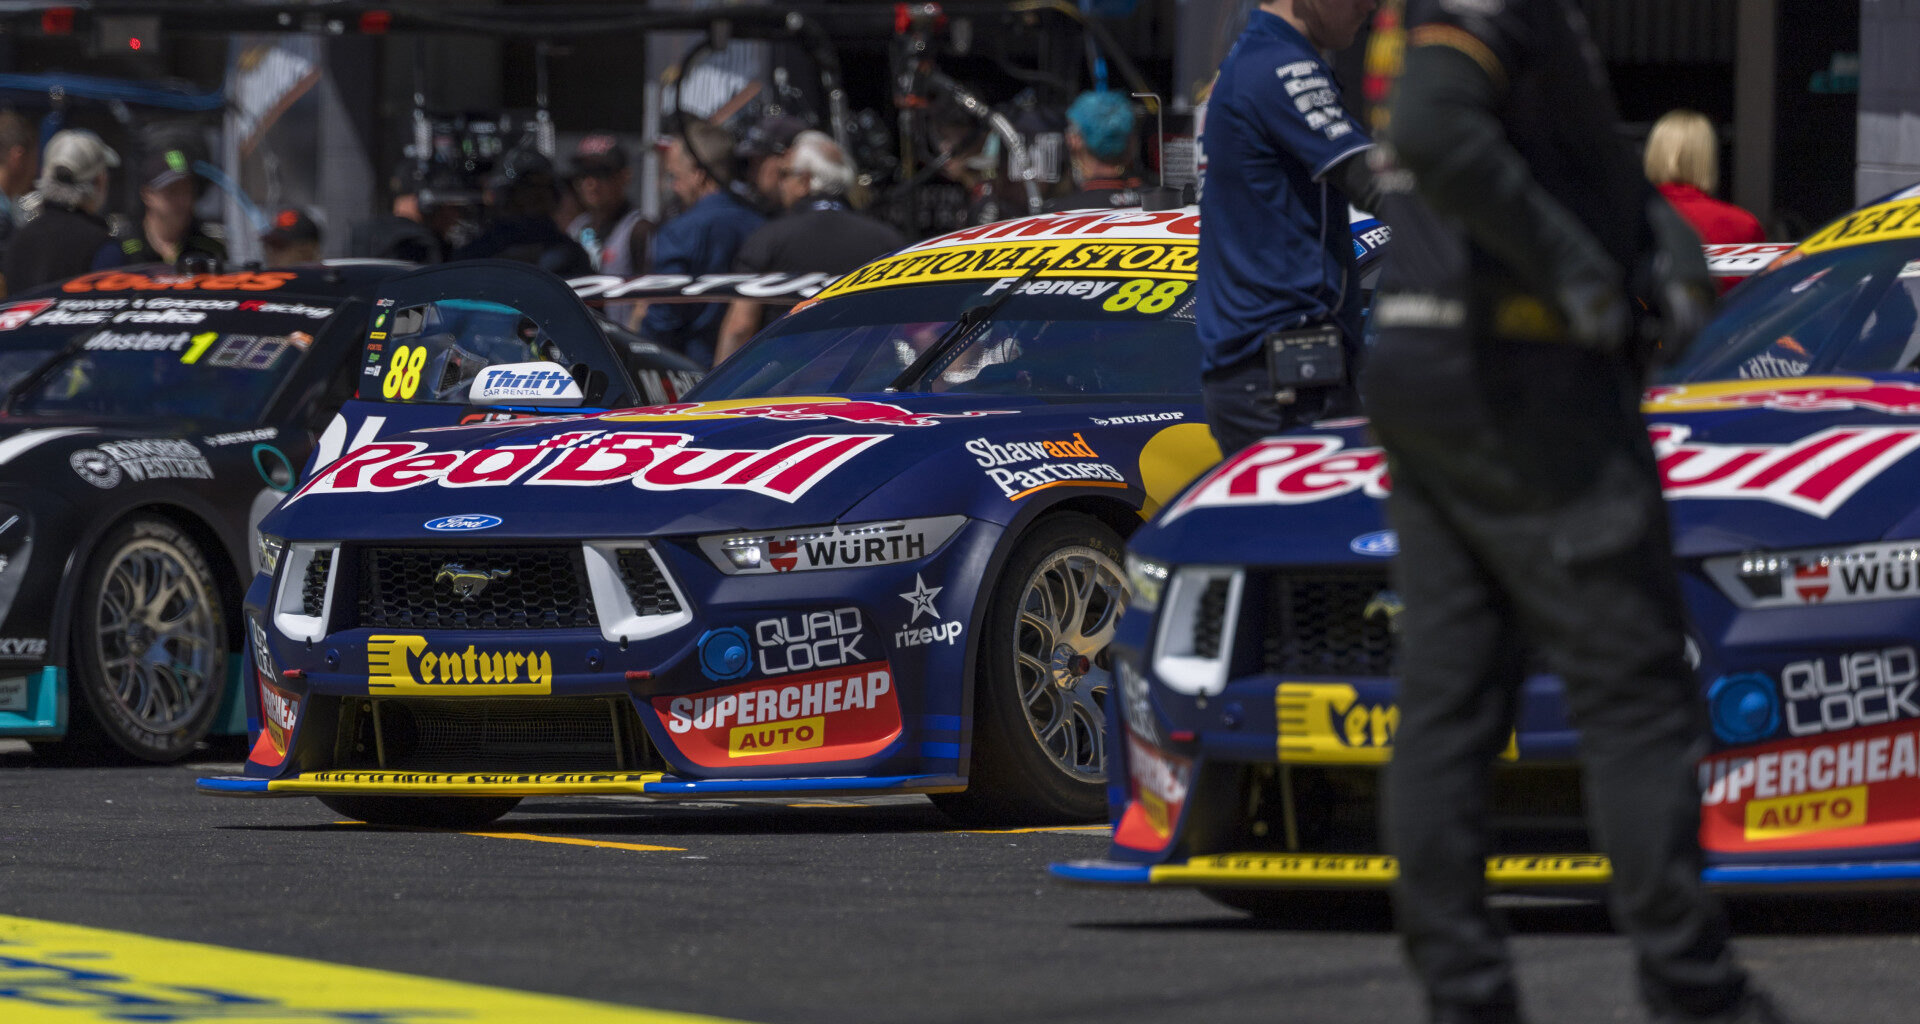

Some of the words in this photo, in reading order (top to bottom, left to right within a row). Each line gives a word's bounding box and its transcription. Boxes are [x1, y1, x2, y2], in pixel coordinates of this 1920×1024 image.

[837, 246, 1062, 290] NATIONAL
[1103, 279, 1189, 314] 88
[180, 331, 219, 365] 1
[382, 345, 427, 399] 88
[484, 370, 573, 396] Thrifty
[483, 388, 500, 397] CAR
[1108, 411, 1184, 425] DUNLOP
[119, 456, 215, 482] WESTERN
[282, 432, 606, 506] Red
[523, 430, 894, 503] Bull
[985, 461, 1125, 498] Partners
[804, 533, 925, 567] WÜRTH
[756, 606, 863, 650] QUAD
[895, 620, 963, 649] rizeup
[367, 634, 553, 695] Century
[758, 633, 867, 675] LOCK
[1781, 645, 1918, 699] QUAD
[668, 670, 891, 734] SUPERCHEAP
[1786, 681, 1920, 737] LOCK
[738, 724, 815, 751] AUTO
[1758, 797, 1855, 831] AUTO
